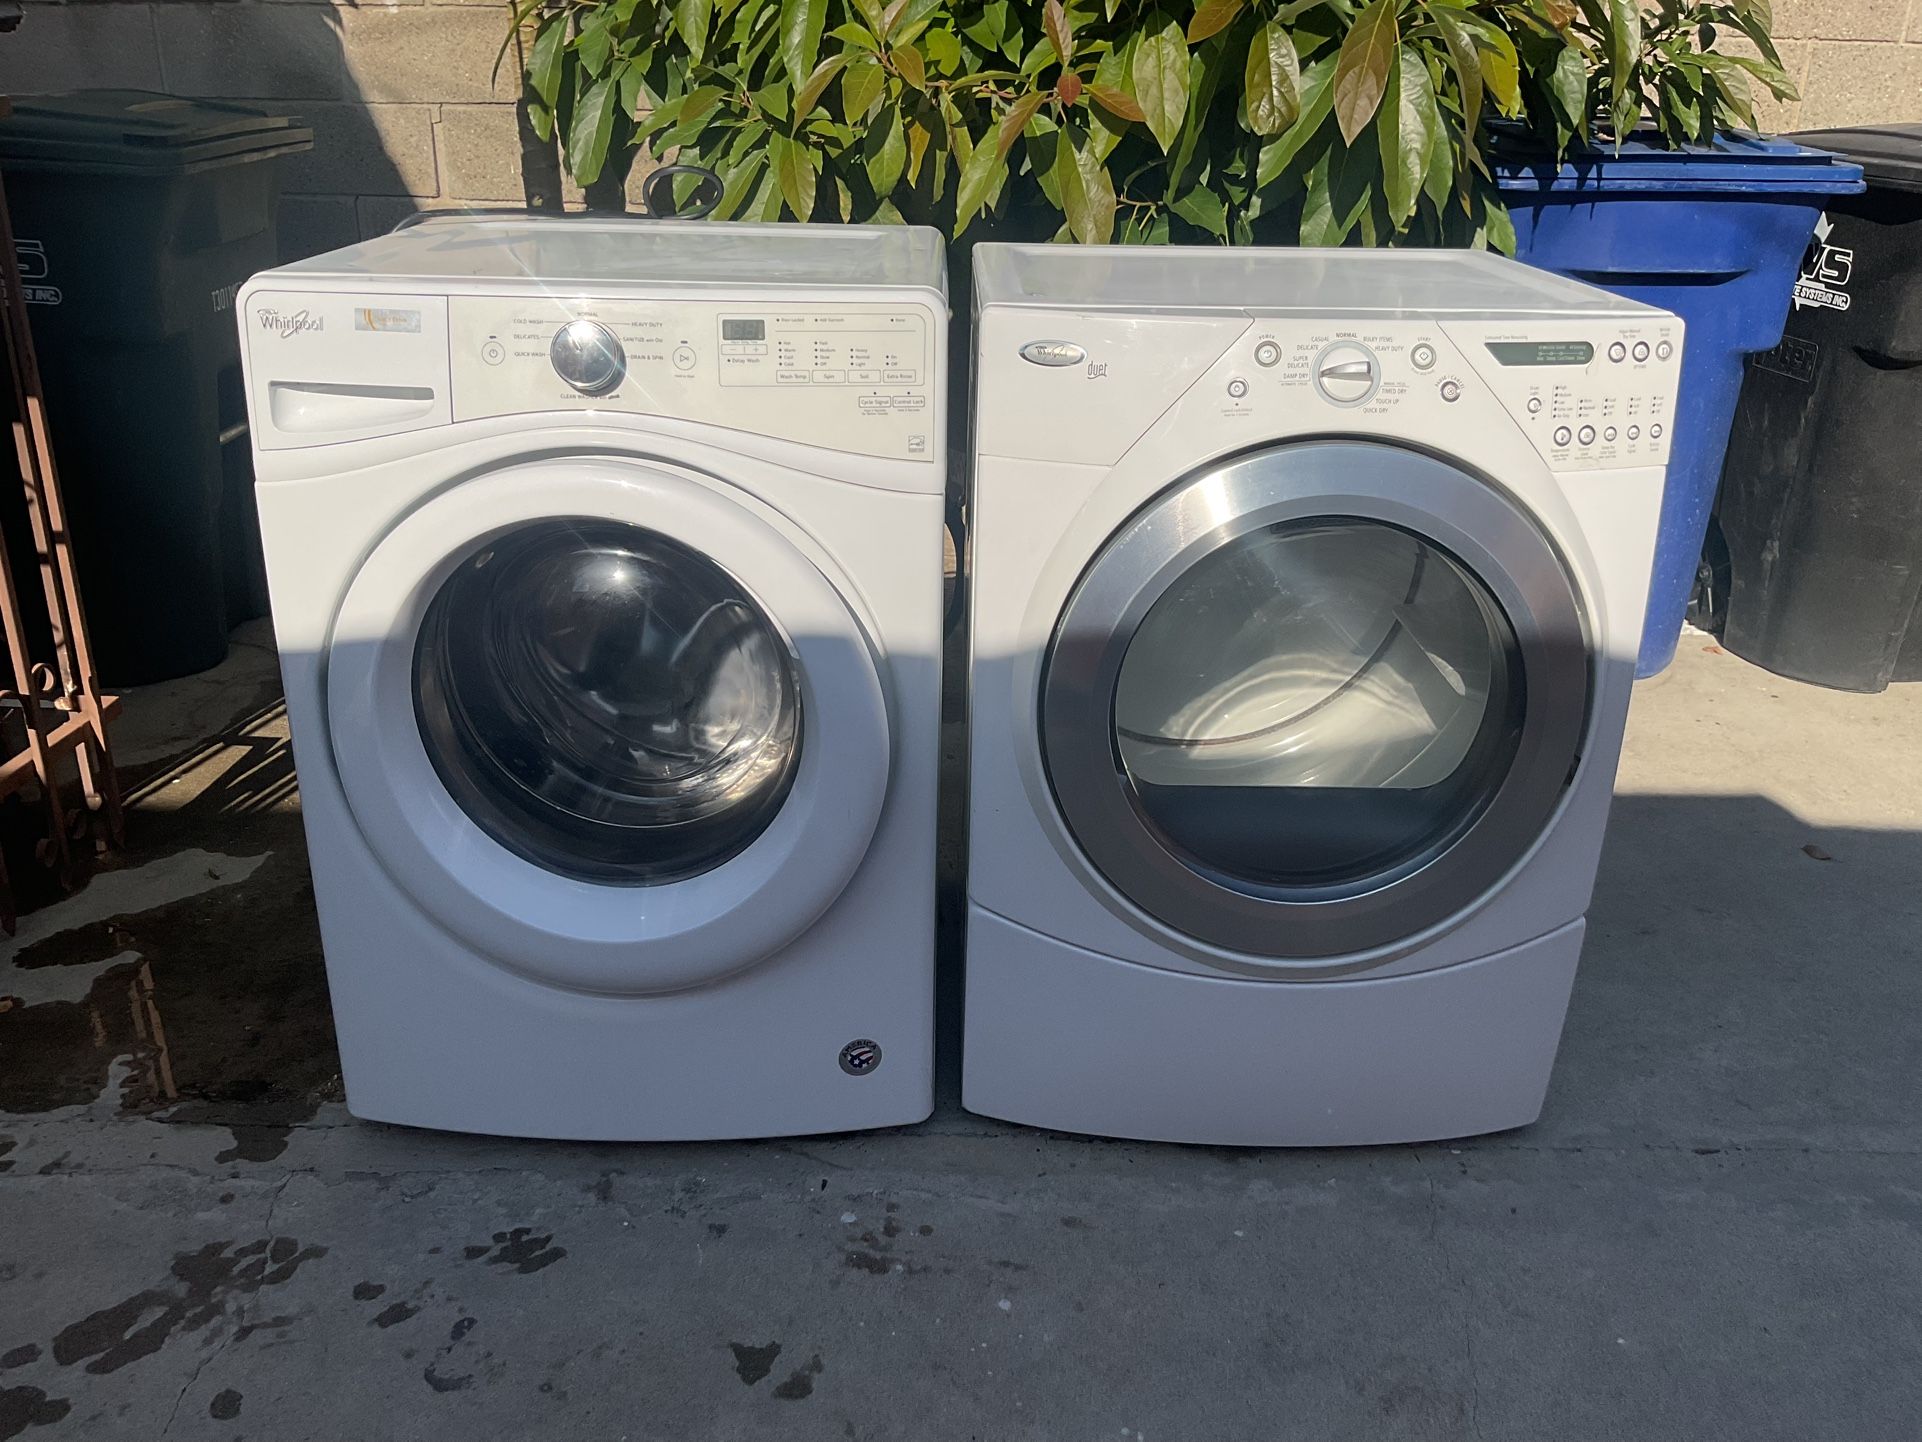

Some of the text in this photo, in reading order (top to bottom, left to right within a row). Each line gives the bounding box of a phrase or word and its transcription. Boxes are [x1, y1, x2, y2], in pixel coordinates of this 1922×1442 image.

[1800, 286, 1833, 304] SYSTEMS
[259, 312, 324, 335] Whirlpool
[1087, 360, 1108, 376] duet
